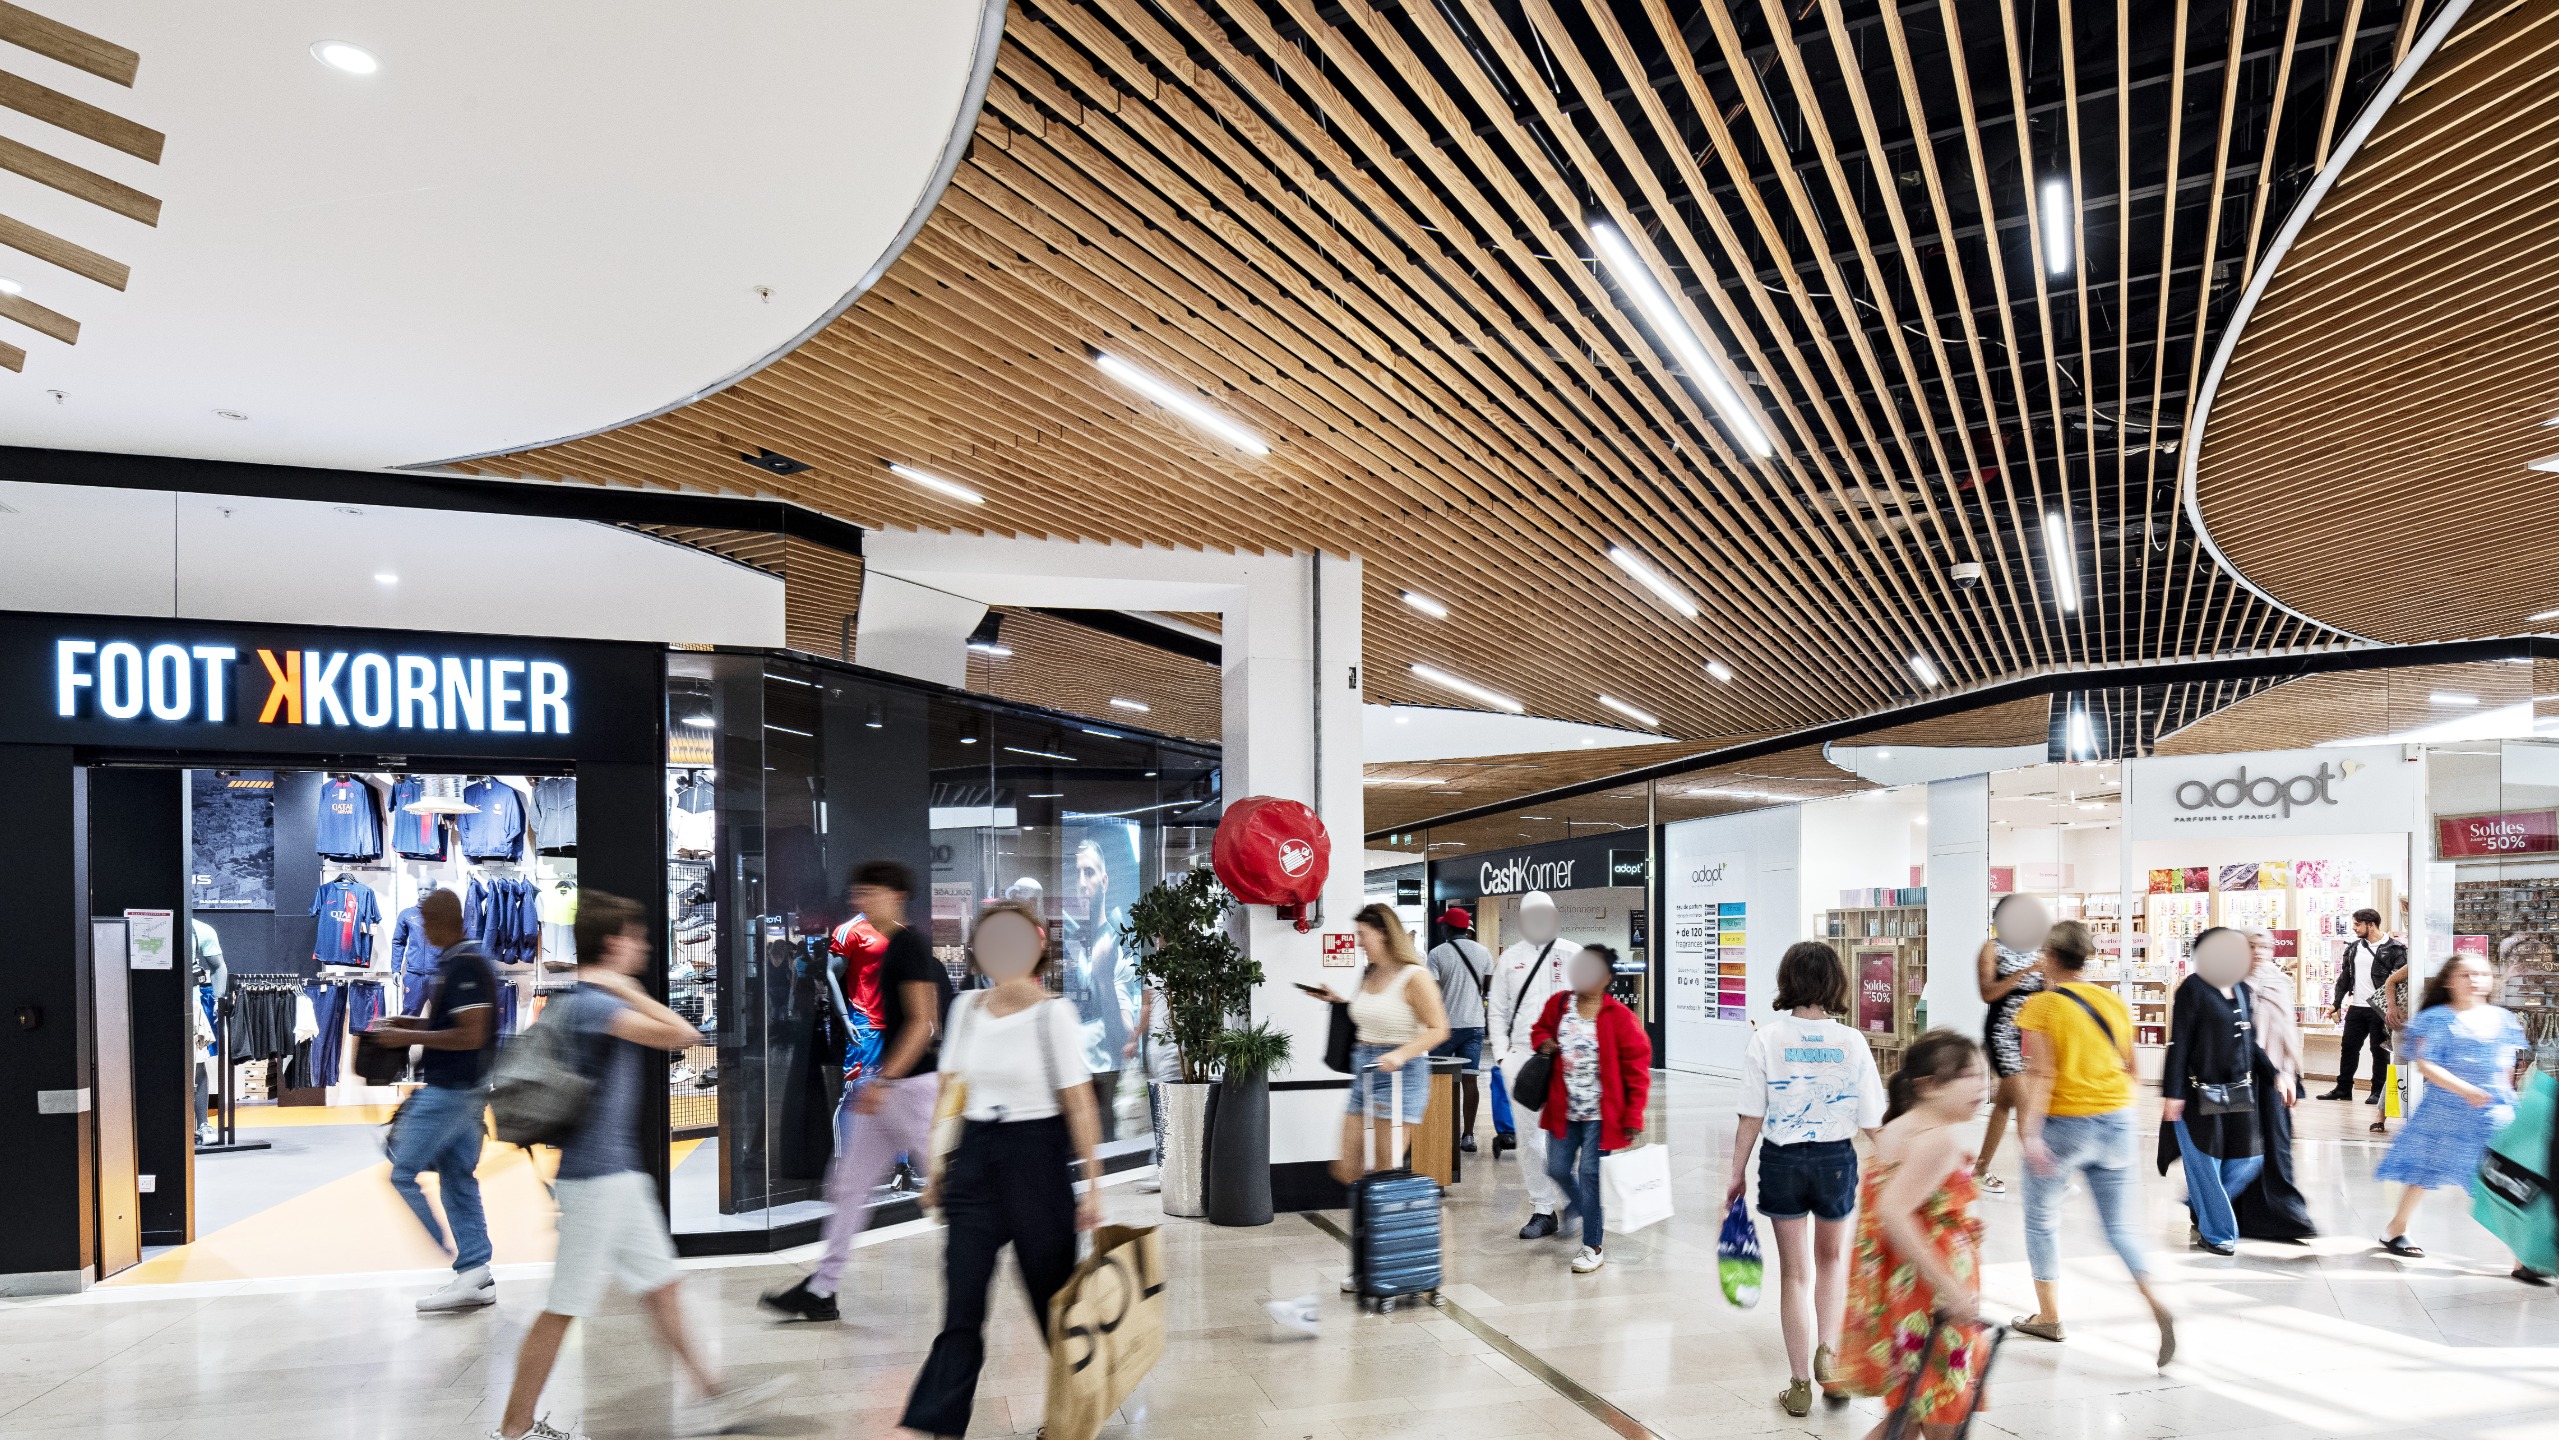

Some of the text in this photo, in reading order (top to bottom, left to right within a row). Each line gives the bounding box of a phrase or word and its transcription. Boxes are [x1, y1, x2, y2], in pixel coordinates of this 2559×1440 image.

[57, 640, 236, 722] FOOT
[2175, 762, 2338, 818] adopt
[2470, 821, 2524, 837] Soldes
[2482, 835, 2526, 850] -50%
[1480, 856, 1575, 894] CashKorner
[1692, 863, 1722, 886] adopt
[1681, 928, 1689, 937] de
[1691, 927, 1703, 937] 120
[1675, 940, 1703, 949] fragrances
[2456, 947, 2484, 955] Soldes
[1863, 979, 1891, 991] Soldes
[1869, 991, 1891, 1003] -50%
[1785, 1048, 1845, 1063] NARUTO
